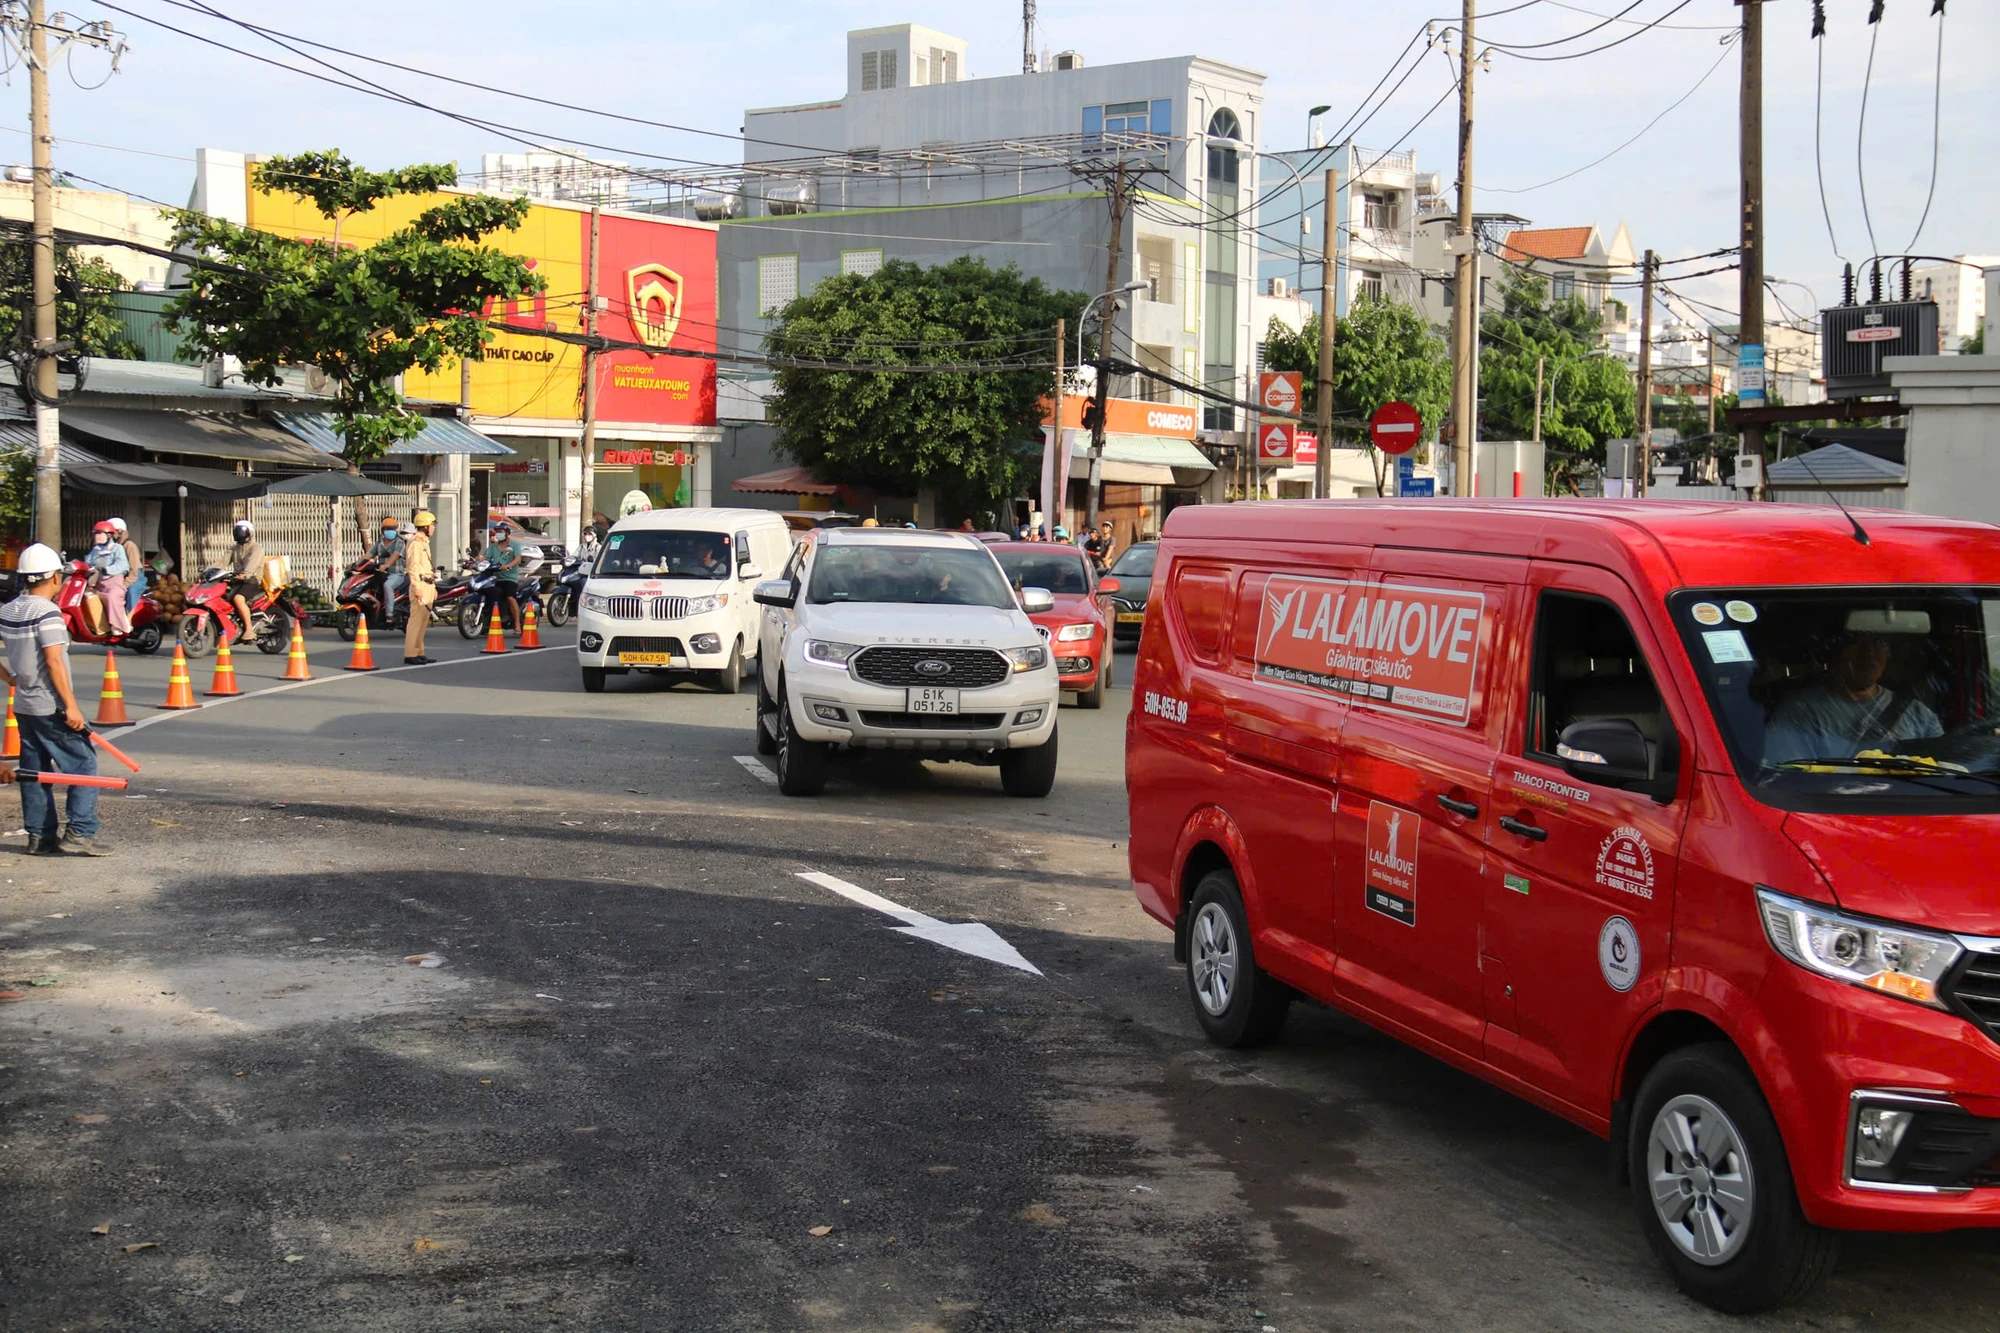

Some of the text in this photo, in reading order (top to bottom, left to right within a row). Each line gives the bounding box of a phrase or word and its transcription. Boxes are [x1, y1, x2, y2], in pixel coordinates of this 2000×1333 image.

[485, 346, 554, 362] THẤT CAO CẤP
[614, 376, 690, 392] VATLIEUXAYDUNG
[1148, 411, 1192, 431] COMECO
[568, 490, 580, 499] 258
[1292, 591, 1478, 663] LALAMOVE
[923, 663, 942, 672] Ford
[923, 689, 945, 700] 61K
[914, 701, 953, 712] 051.26
[1144, 691, 1188, 724] 50H-855.98
[1514, 771, 1590, 802] THACO FRONTIER
[1369, 848, 1413, 876] LALAMOVE
